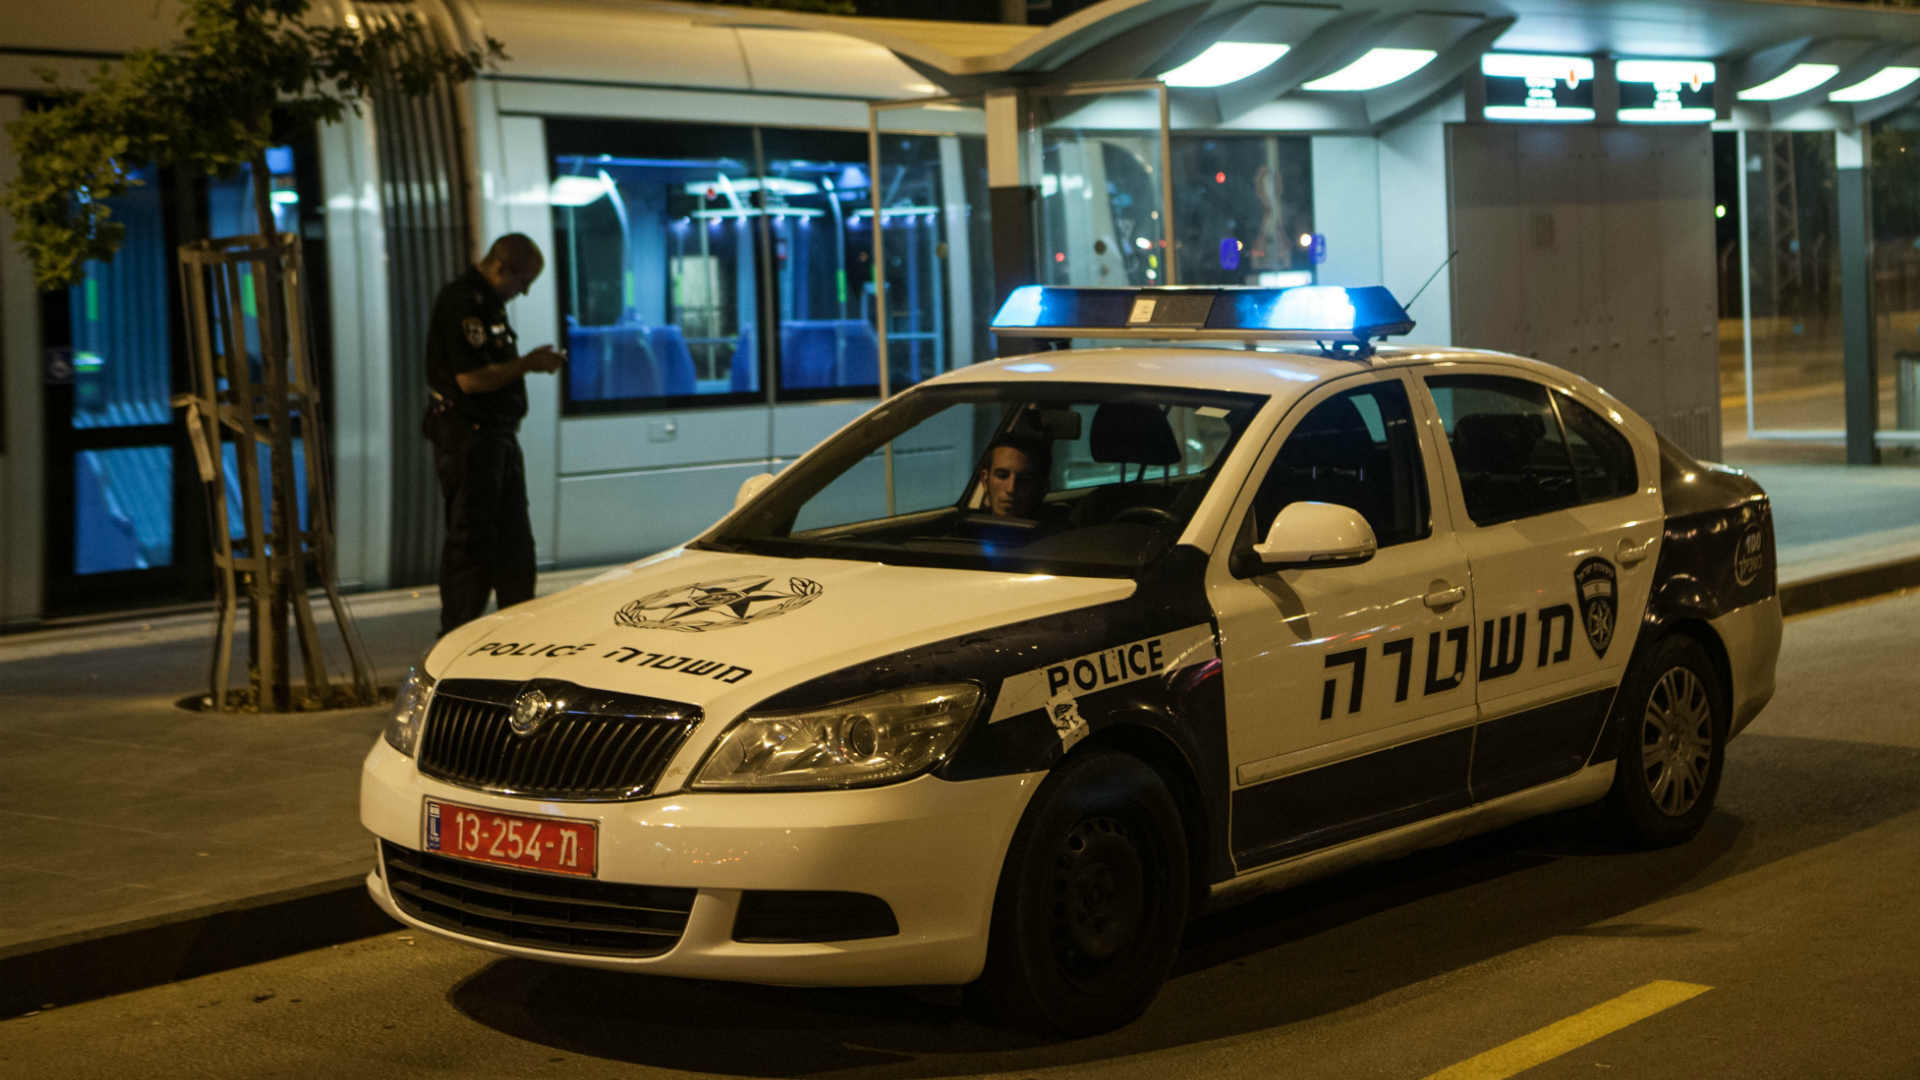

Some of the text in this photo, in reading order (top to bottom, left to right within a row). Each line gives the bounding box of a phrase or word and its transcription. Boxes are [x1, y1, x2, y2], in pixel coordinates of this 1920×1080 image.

[603, 646, 753, 685] משטרה
[1046, 639, 1164, 697] POLICE
[1320, 603, 1575, 721] משטרה
